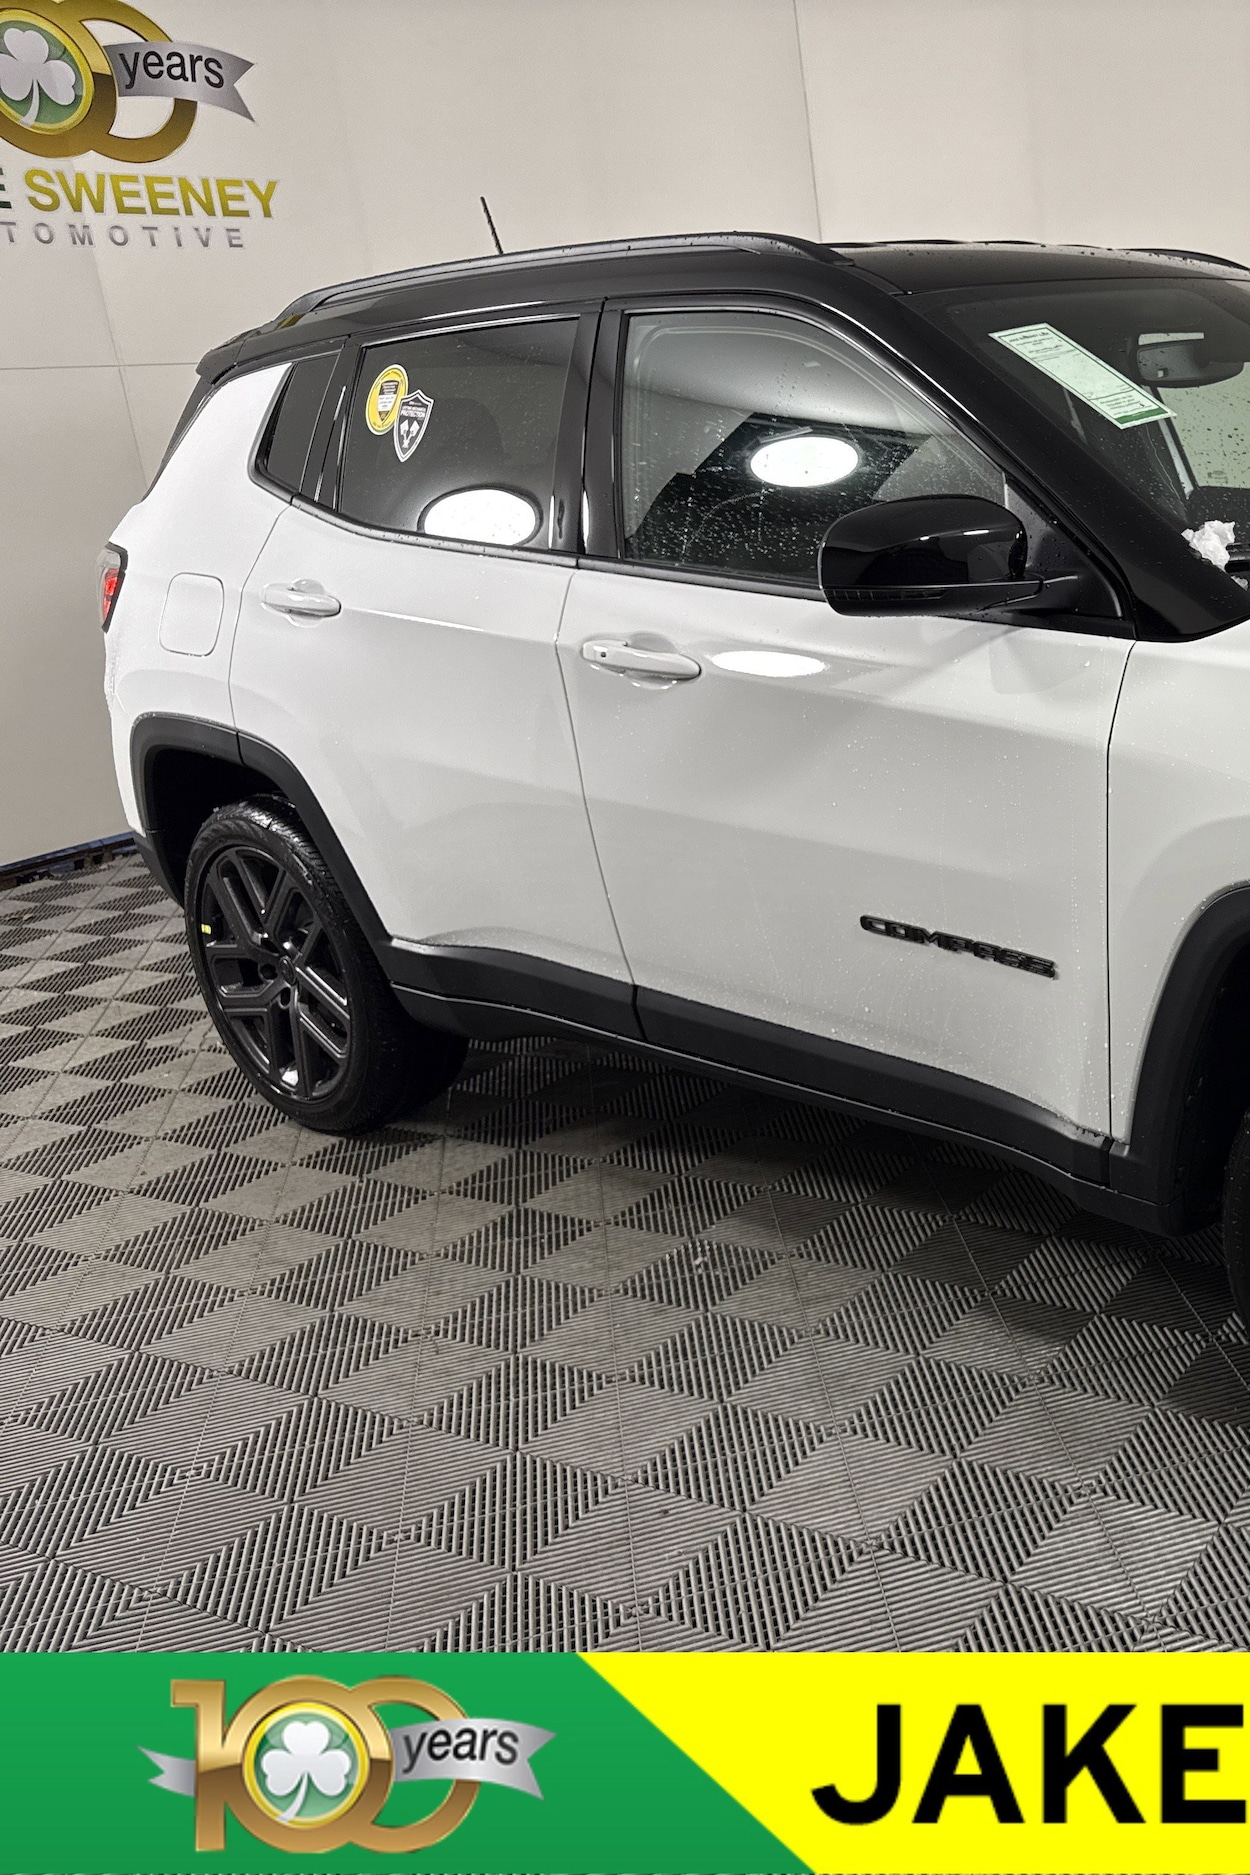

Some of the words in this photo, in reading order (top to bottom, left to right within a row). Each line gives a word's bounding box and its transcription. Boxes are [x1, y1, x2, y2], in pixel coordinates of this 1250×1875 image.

[118, 50, 225, 90] years
[24, 168, 278, 218] SWEENEY
[0, 221, 244, 248] TOMOTIVE
[860, 914, 1056, 978] COMPASS
